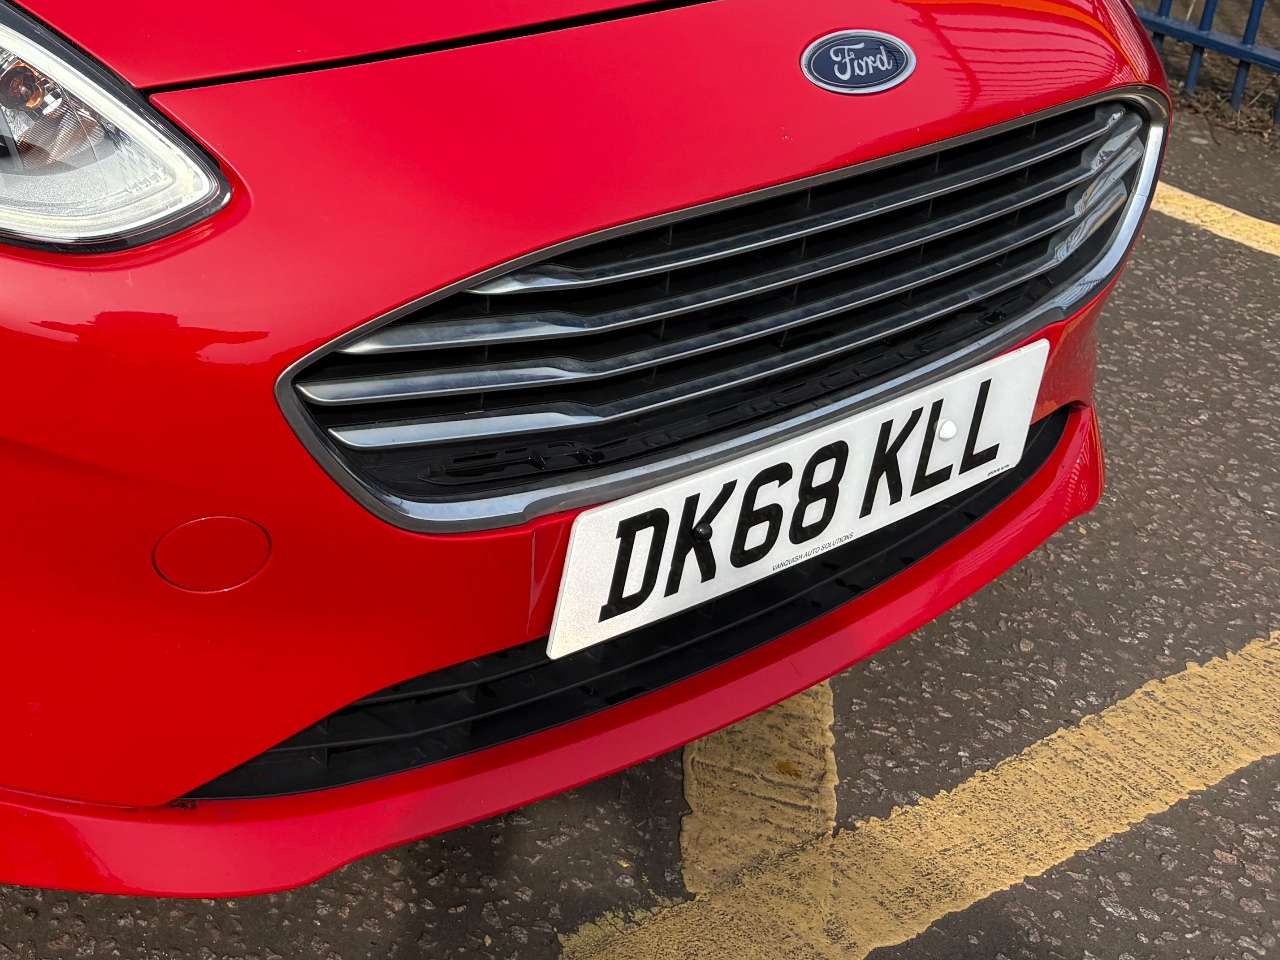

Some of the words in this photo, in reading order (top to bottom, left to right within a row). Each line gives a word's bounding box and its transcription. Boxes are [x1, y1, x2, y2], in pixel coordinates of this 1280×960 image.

[829, 42, 893, 81] Ford
[597, 439, 849, 623] DK68
[858, 378, 1000, 519] KLL
[772, 551, 803, 571] VANQUISH
[803, 546, 821, 559] AUTO
[821, 531, 854, 551] SOLUTIONS
